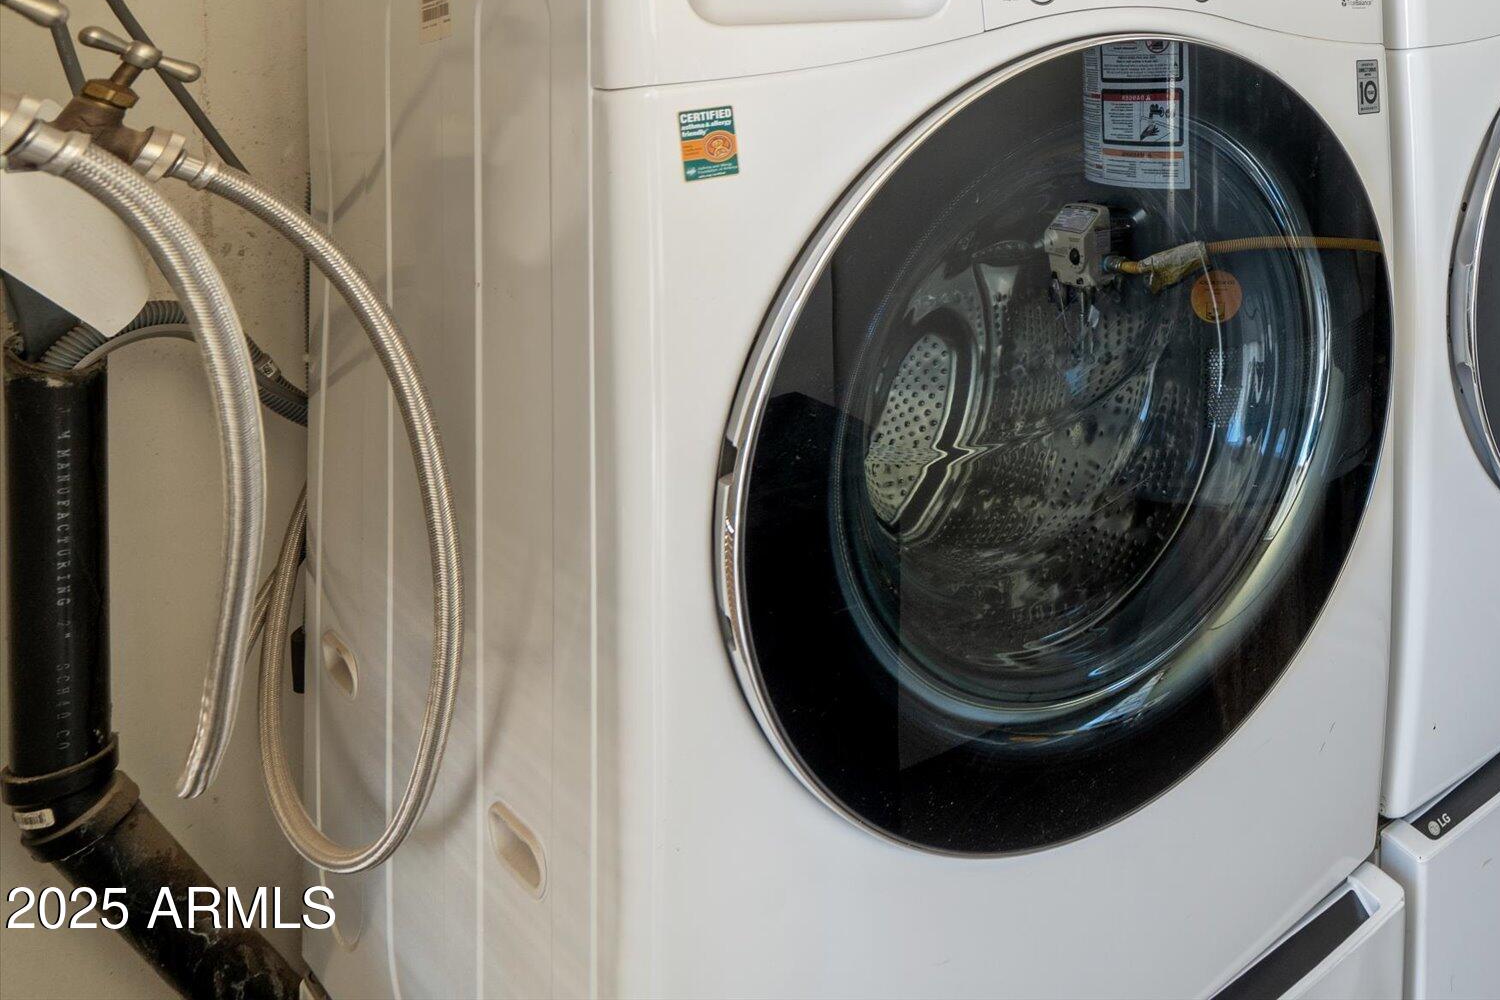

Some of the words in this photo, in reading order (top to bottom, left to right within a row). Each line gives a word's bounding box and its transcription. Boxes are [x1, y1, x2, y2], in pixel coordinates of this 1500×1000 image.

[1360, 81, 1377, 104] 10
[680, 108, 731, 123] CERTIFIED
[56, 448, 72, 607] MANUFACTURING
[1437, 812, 1452, 830] LG
